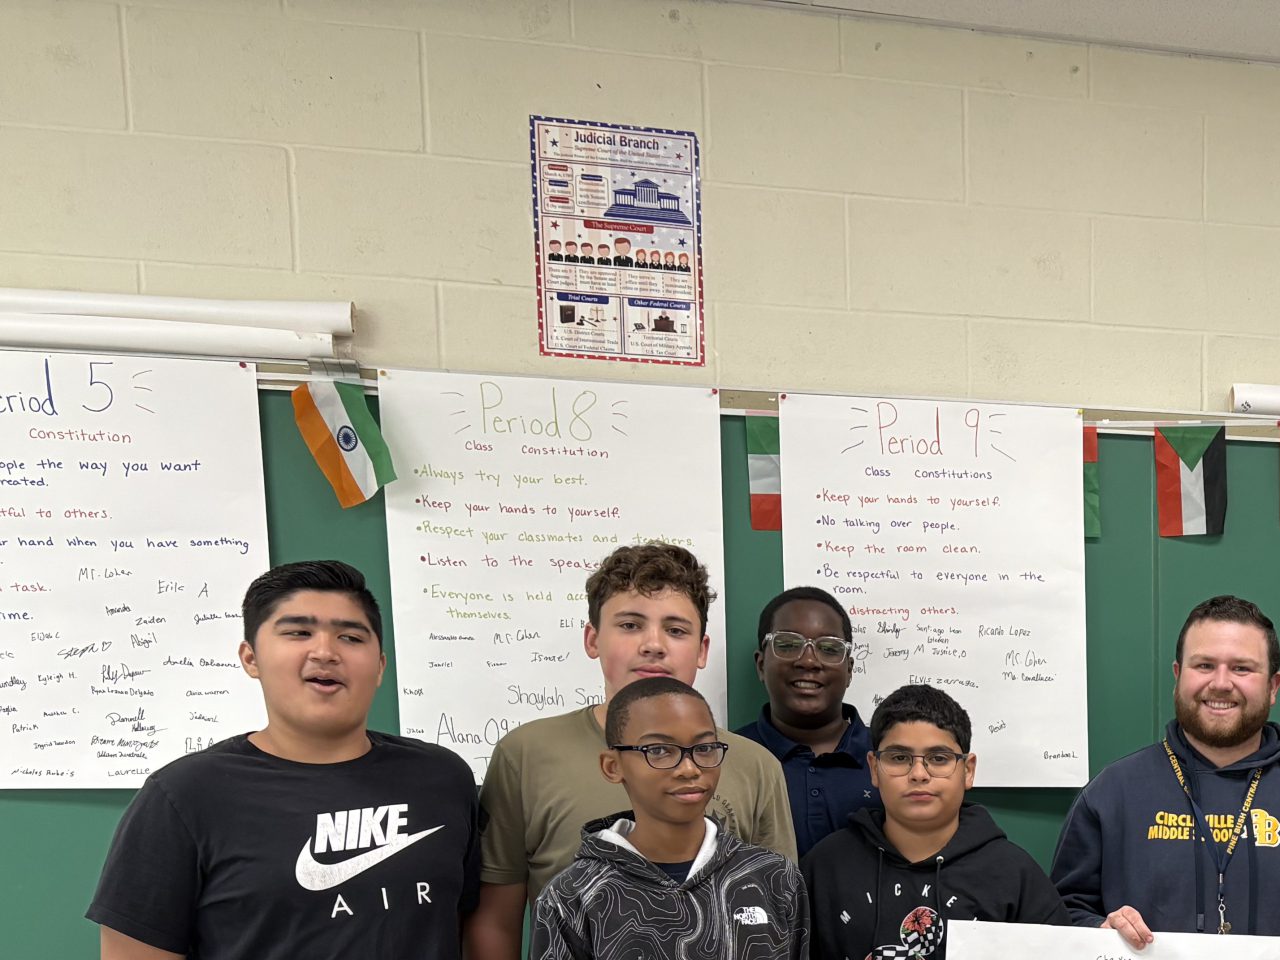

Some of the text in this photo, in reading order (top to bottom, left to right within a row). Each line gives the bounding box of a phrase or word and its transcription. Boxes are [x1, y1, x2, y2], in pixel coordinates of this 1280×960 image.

[574, 130, 659, 150] Judicial Branch
[591, 221, 647, 232] The Supreme Court
[0, 358, 114, 415] riod 5
[480, 382, 597, 442] Period 8
[29, 428, 132, 444] Constitution
[877, 402, 980, 458] Period 9
[464, 440, 609, 458] Class Constitution
[0, 459, 202, 478] ople the way you want
[418, 464, 588, 488] Always try your best.
[864, 466, 992, 480] Class Constitutions
[0, 476, 49, 487] reated.
[422, 495, 620, 522] Keep your hands to yourself.
[822, 488, 1000, 511] Keep your hands to yourself.
[35, 508, 113, 520] to others.
[822, 516, 960, 534] No talking over people.
[423, 524, 474, 540] Respect
[482, 530, 508, 546] your
[518, 530, 583, 544] classmates
[592, 533, 618, 544] and
[18, 536, 54, 546] hand
[66, 537, 97, 548] when
[111, 539, 134, 552] you
[147, 538, 179, 548] have
[190, 538, 250, 555] something
[825, 540, 981, 558] Keep the room clean.
[427, 554, 604, 572] Listen to the speake
[824, 563, 1045, 586] Be respectful to everyone in the
[10, 582, 52, 592] task.
[198, 582, 209, 598] A
[432, 584, 552, 606] Everyone is held
[832, 584, 866, 595] room.
[0, 610, 34, 620] ime.
[446, 606, 512, 620] themselves.
[849, 606, 959, 622] distracting others.
[508, 685, 605, 711] Shaylah Smi
[1169, 754, 1185, 786] CENTRAL
[1155, 810, 1234, 828] CIRCLILLE
[1226, 834, 1239, 855] PINE
[1234, 812, 1246, 834] BUSH
[1242, 780, 1259, 812] CENTRAL
[314, 804, 408, 854] NIKE
[1148, 826, 1190, 840] MIDDLE
[331, 882, 432, 918] AIR
